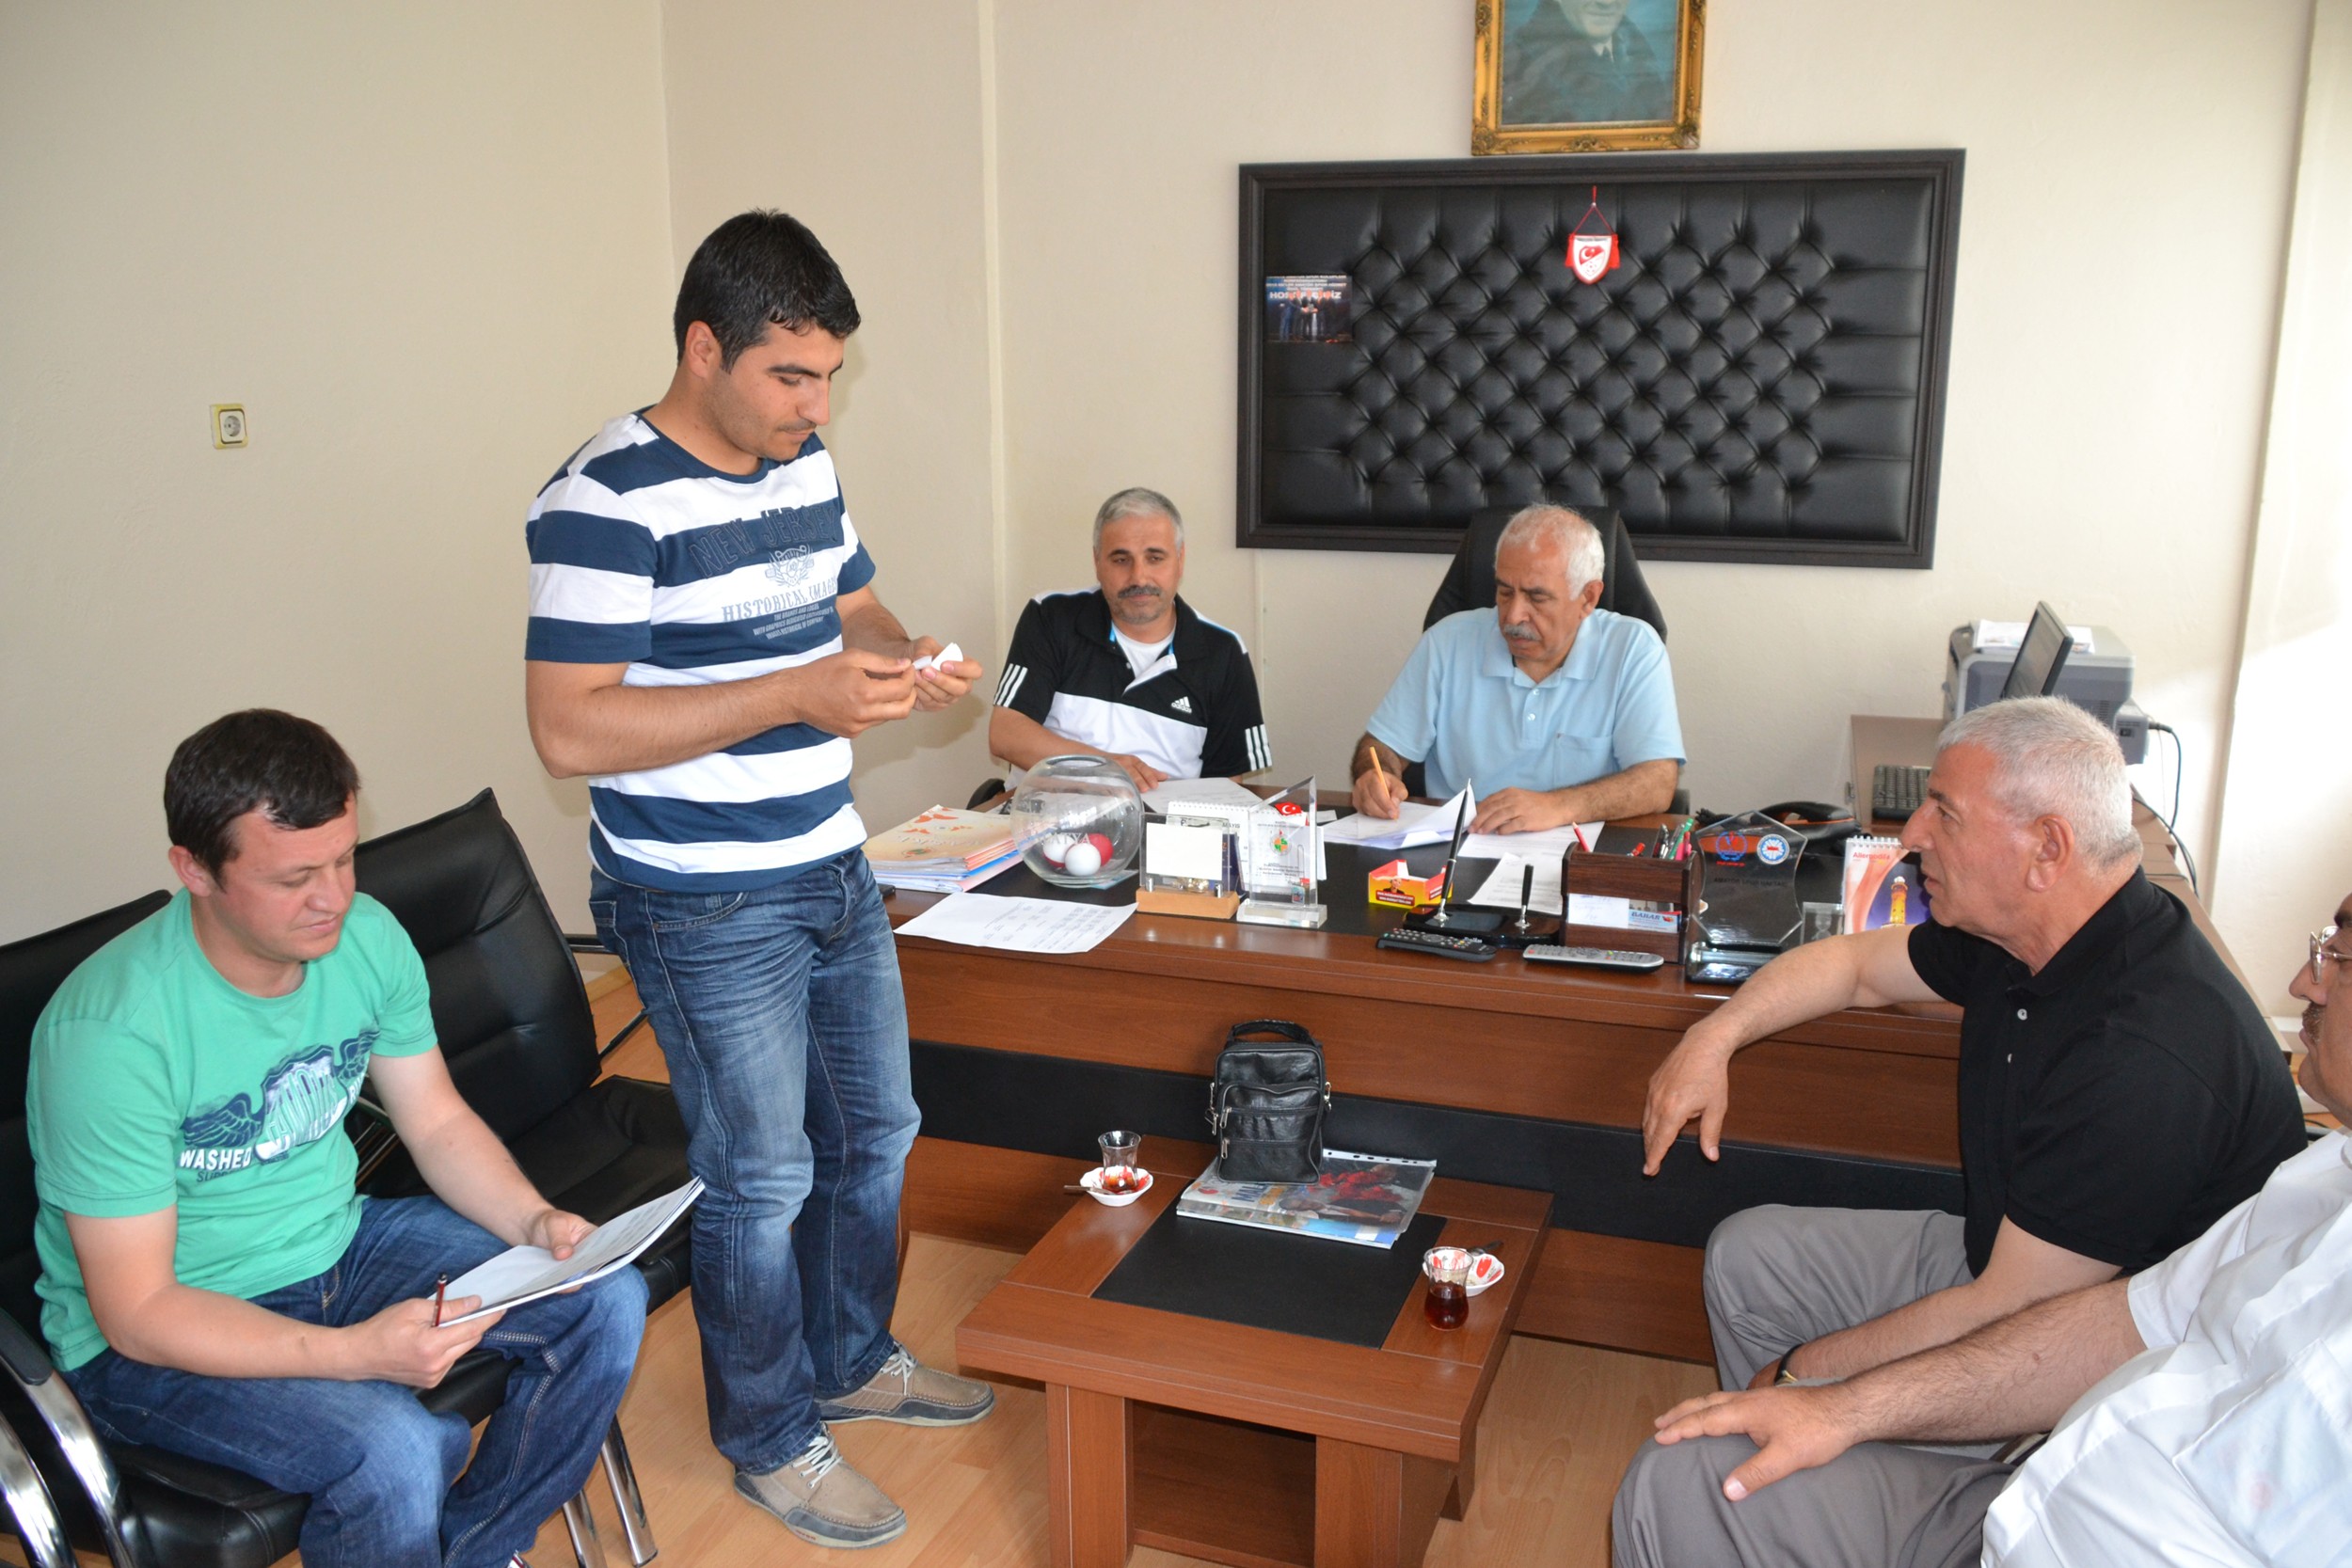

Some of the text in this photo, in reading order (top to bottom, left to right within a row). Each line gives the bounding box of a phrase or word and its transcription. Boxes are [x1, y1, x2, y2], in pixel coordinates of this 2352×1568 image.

[689, 504, 839, 578] NEW JERSEY
[721, 589, 808, 624] HISTORICAL
[1171, 703, 1192, 714] adidas
[180, 1147, 252, 1171] WASHED
